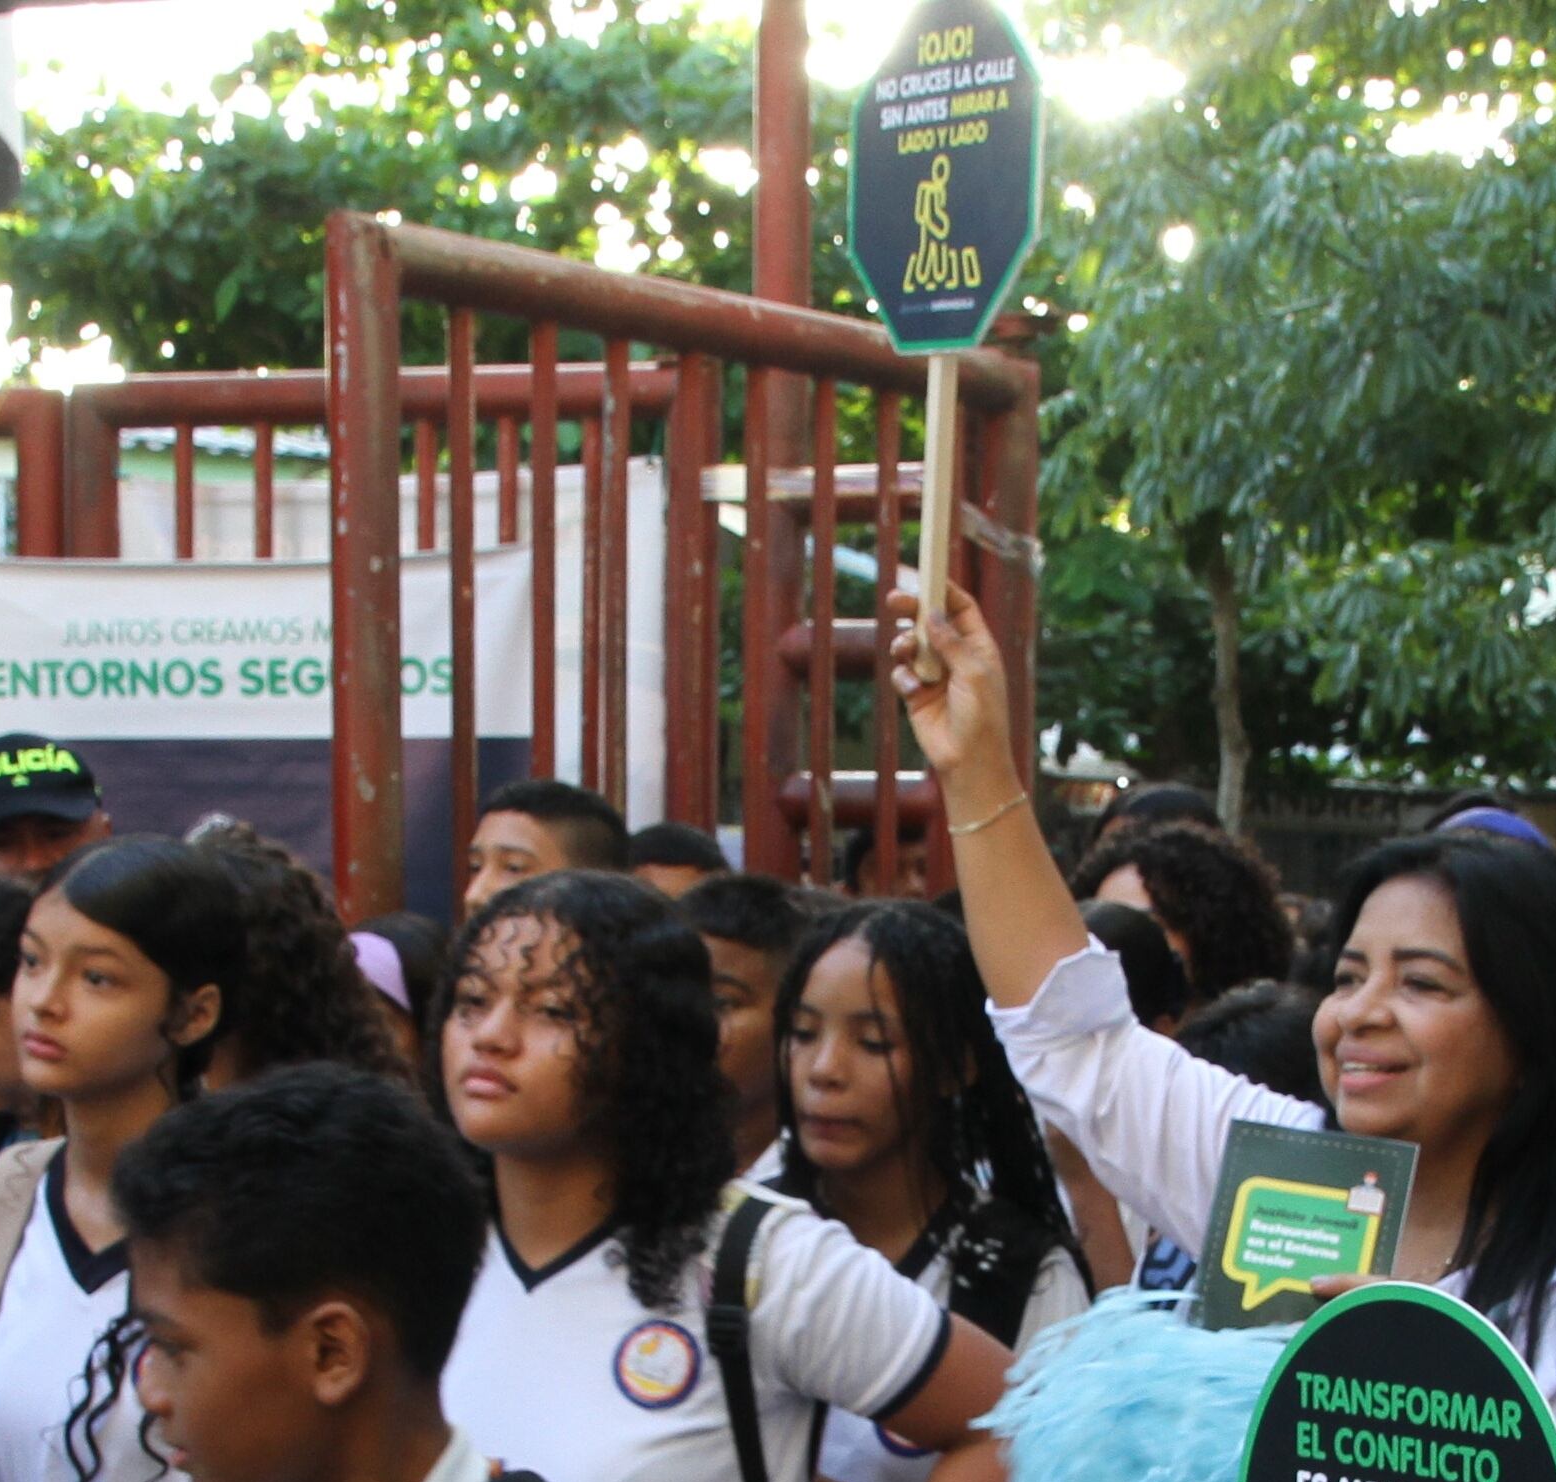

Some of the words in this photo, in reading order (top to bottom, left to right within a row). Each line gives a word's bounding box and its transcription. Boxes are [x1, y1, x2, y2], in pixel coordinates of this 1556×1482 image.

[917, 24, 974, 66] ¡OJO!
[875, 77, 898, 102] NO
[899, 70, 951, 99] CRUCES
[953, 66, 972, 90] LA
[974, 57, 1016, 85] CALLE
[879, 105, 904, 130] SIN
[904, 97, 948, 125] ANTES
[950, 91, 994, 118] MIRAR
[995, 89, 1009, 111] A
[898, 129, 934, 155] LADO
[936, 126, 948, 149] Y
[949, 120, 988, 147] LADO
[61, 618, 161, 647] JUNTOS
[171, 616, 303, 644] CREAMOS
[240, 657, 453, 695] SEGOS
[1296, 1371, 1522, 1440] TRANSFORMAR
[1296, 1421, 1326, 1460] EL
